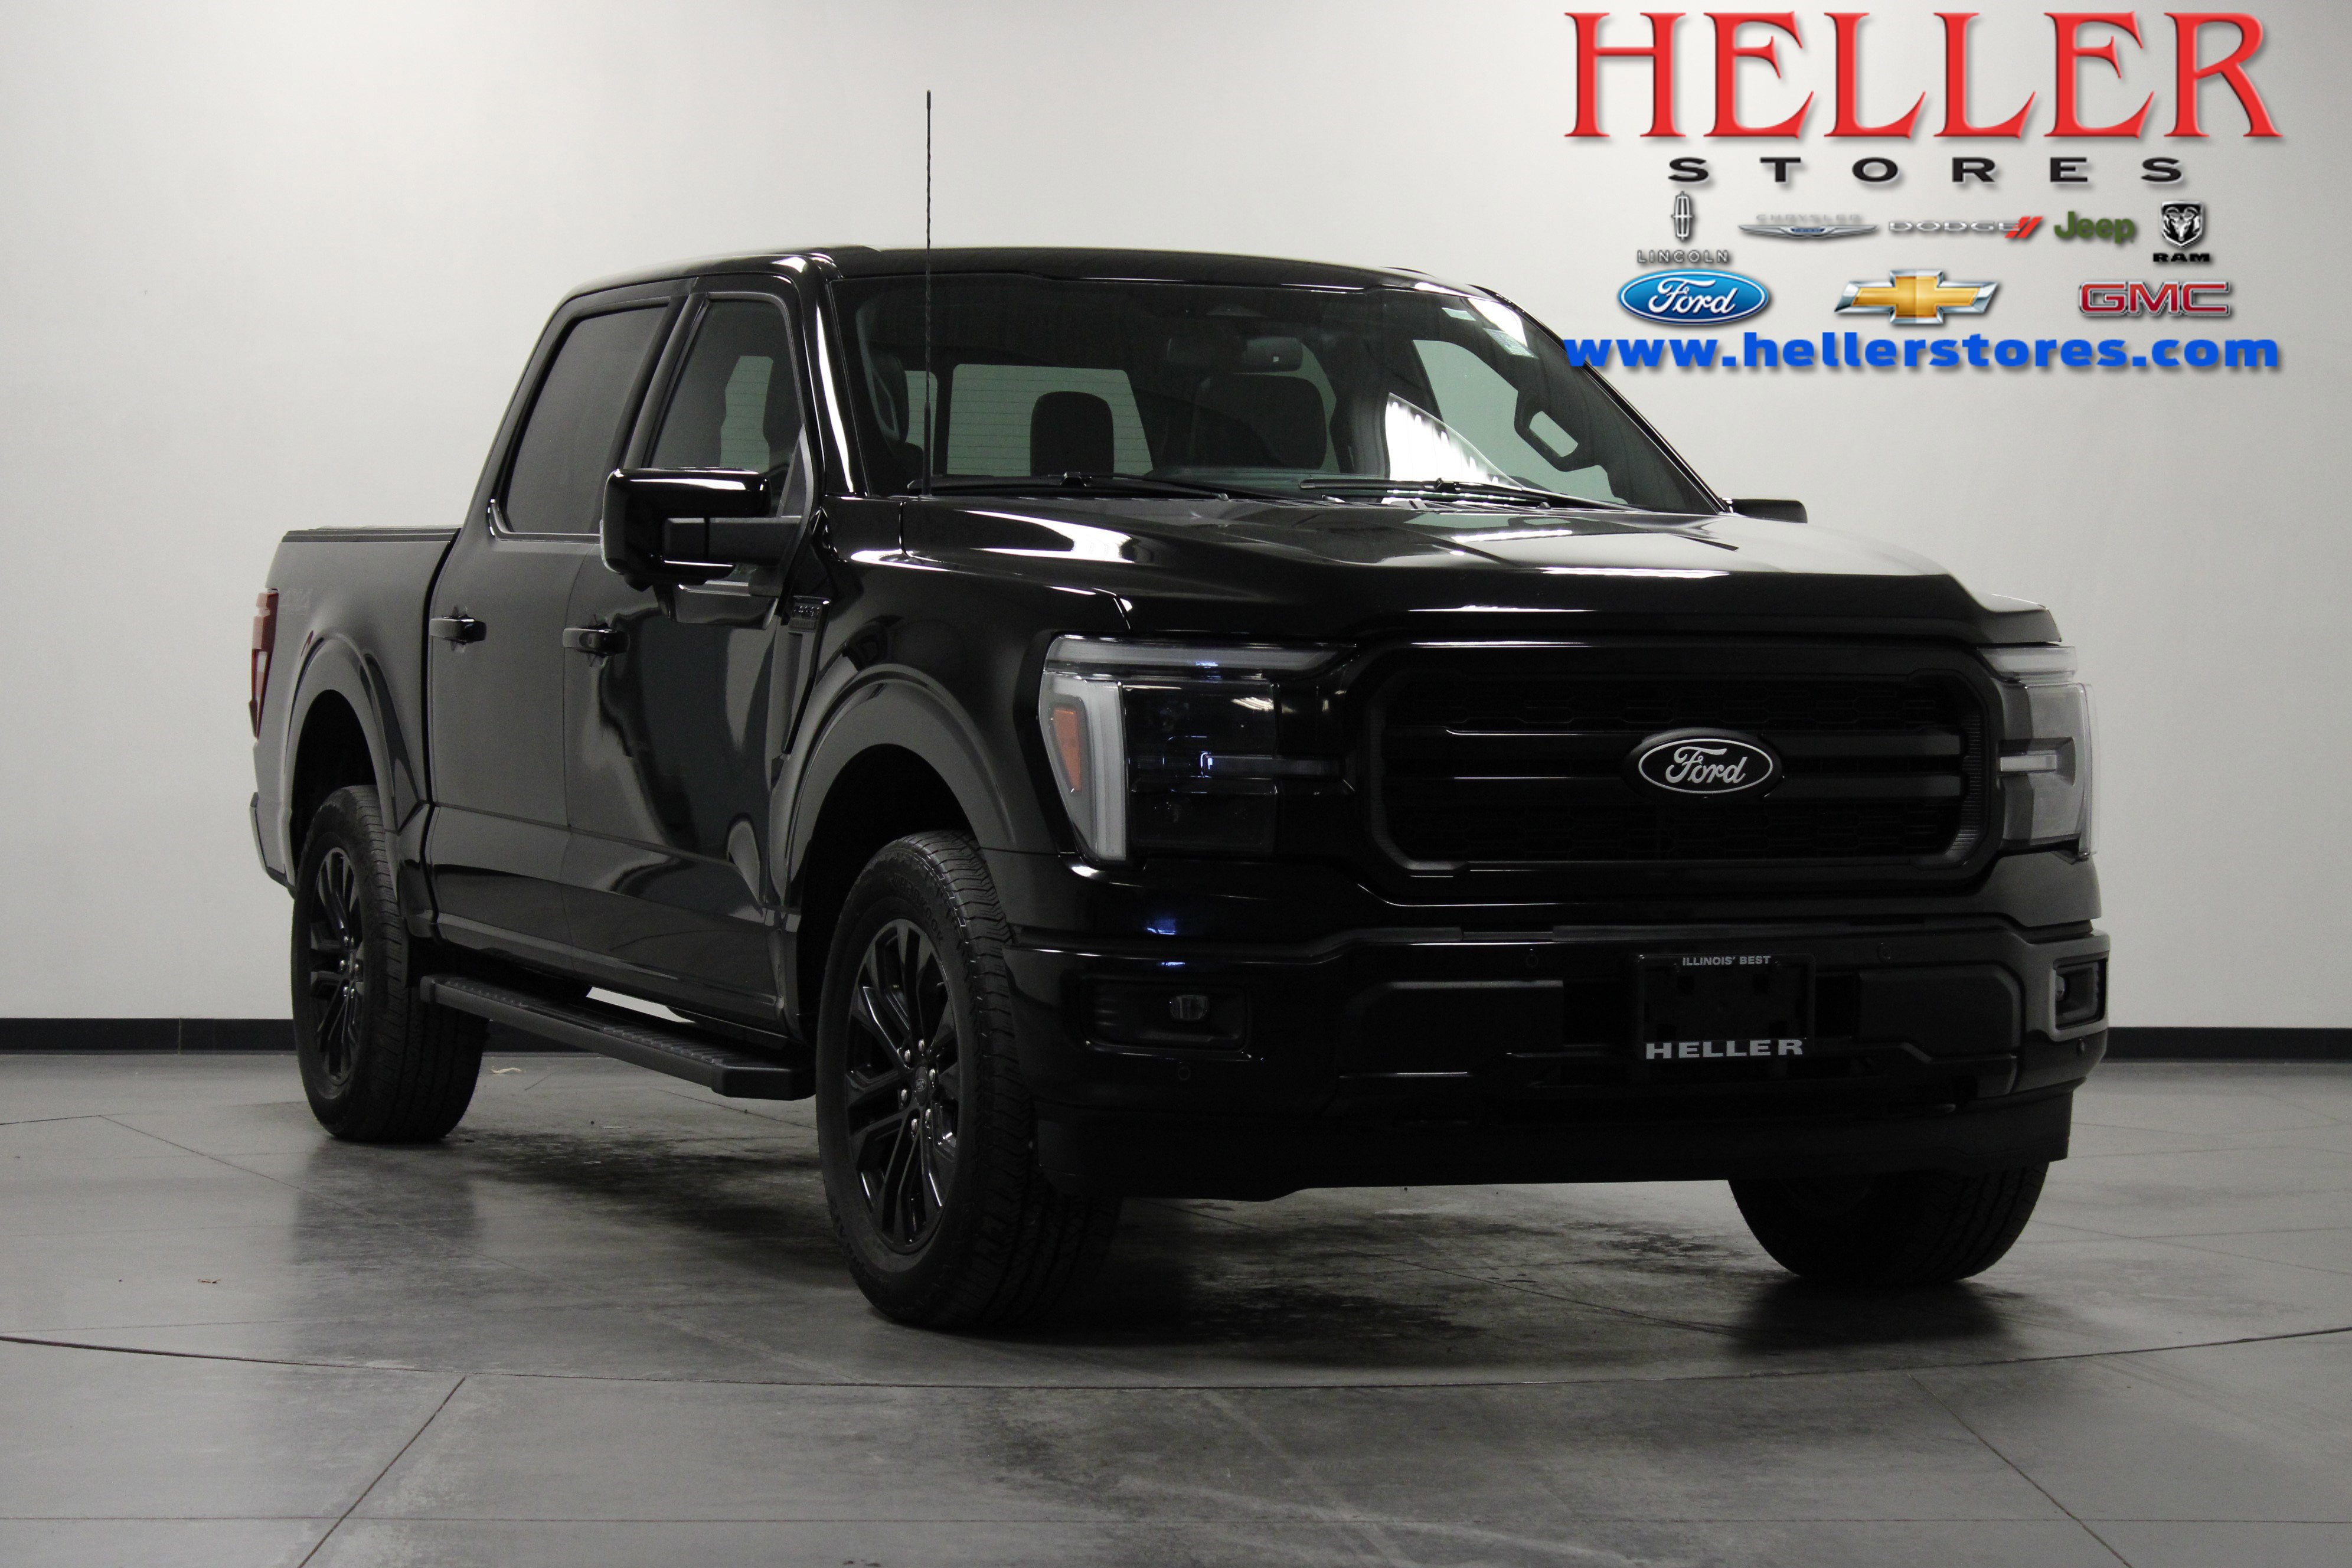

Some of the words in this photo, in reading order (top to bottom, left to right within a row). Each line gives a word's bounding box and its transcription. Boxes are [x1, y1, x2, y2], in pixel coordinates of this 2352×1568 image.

[1665, 746, 1747, 784] Ford
[1739, 955, 1771, 965] BEST
[1645, 1038, 1804, 1060] HELLER
